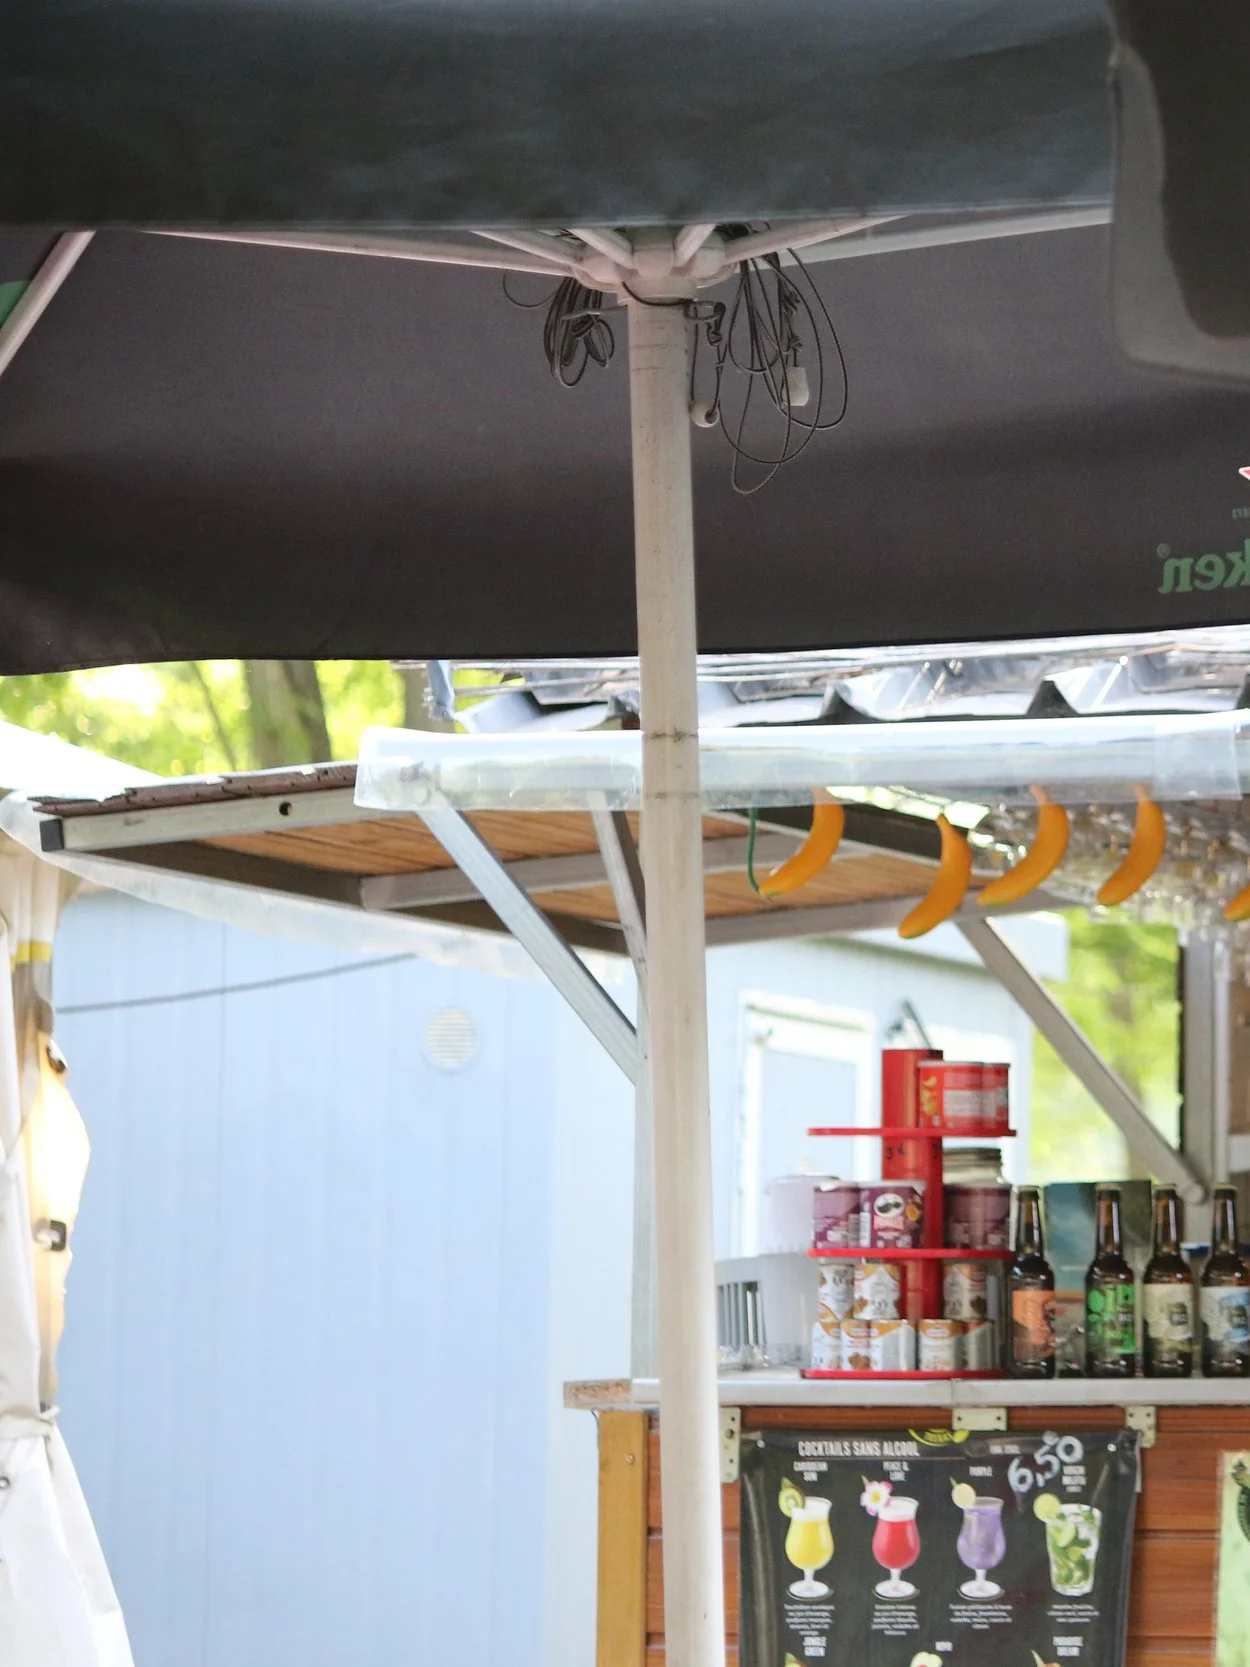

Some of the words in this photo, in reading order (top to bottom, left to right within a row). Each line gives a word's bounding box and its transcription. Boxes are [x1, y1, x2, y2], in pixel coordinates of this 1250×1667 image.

[798, 1440, 851, 1457] COCKTAILS
[852, 1440, 882, 1456] SANS
[882, 1440, 921, 1457] ALCOOL
[1007, 1431, 1085, 1493] 6,50
